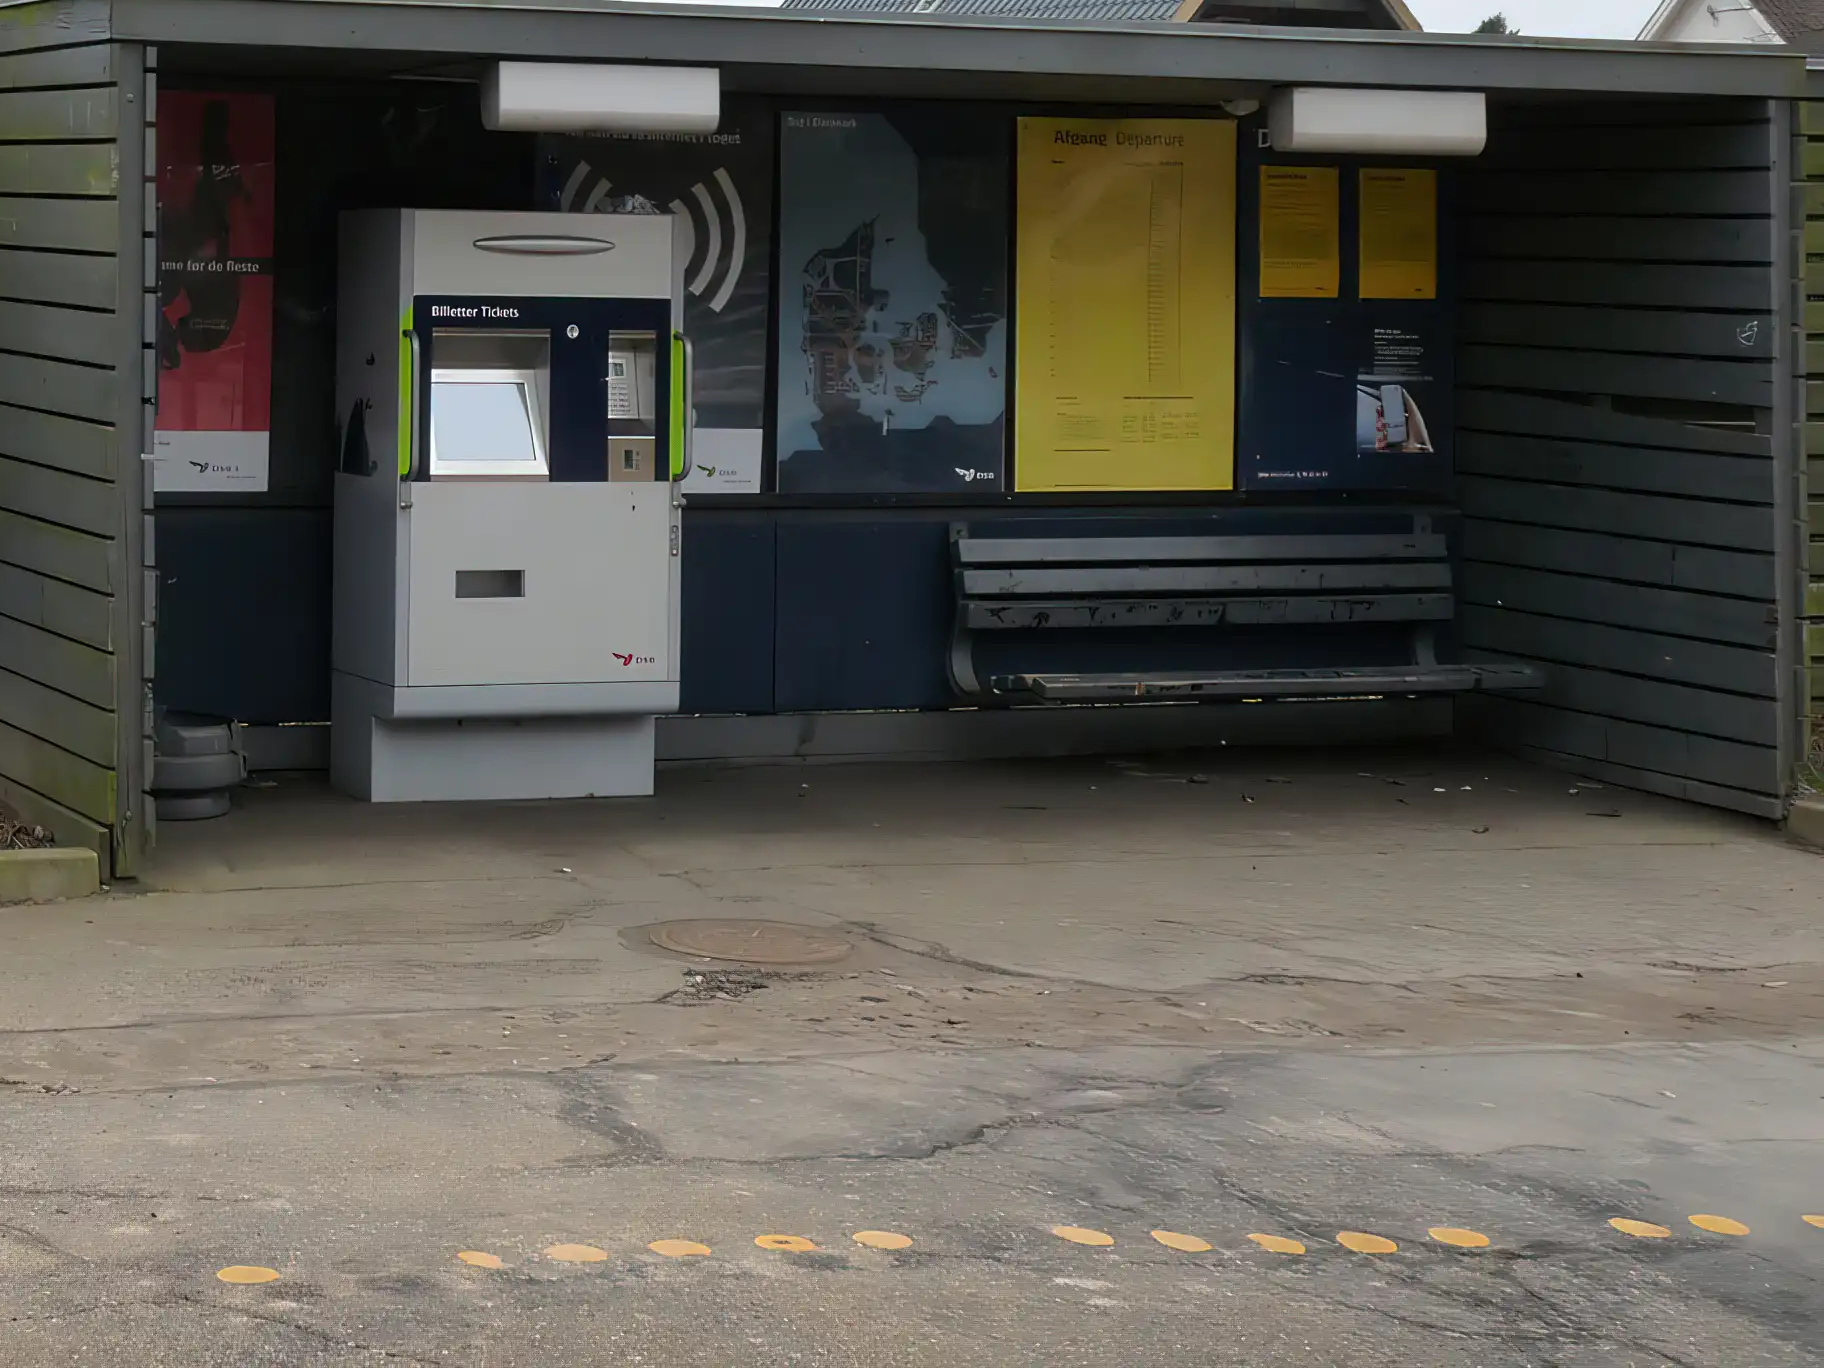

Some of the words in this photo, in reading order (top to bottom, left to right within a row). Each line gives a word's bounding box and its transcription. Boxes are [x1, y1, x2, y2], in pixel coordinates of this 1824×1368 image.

[1054, 130, 1107, 146] Afgang
[1116, 131, 1185, 149] Departure
[431, 305, 478, 317] Billetter
[481, 306, 519, 318] Tickets
